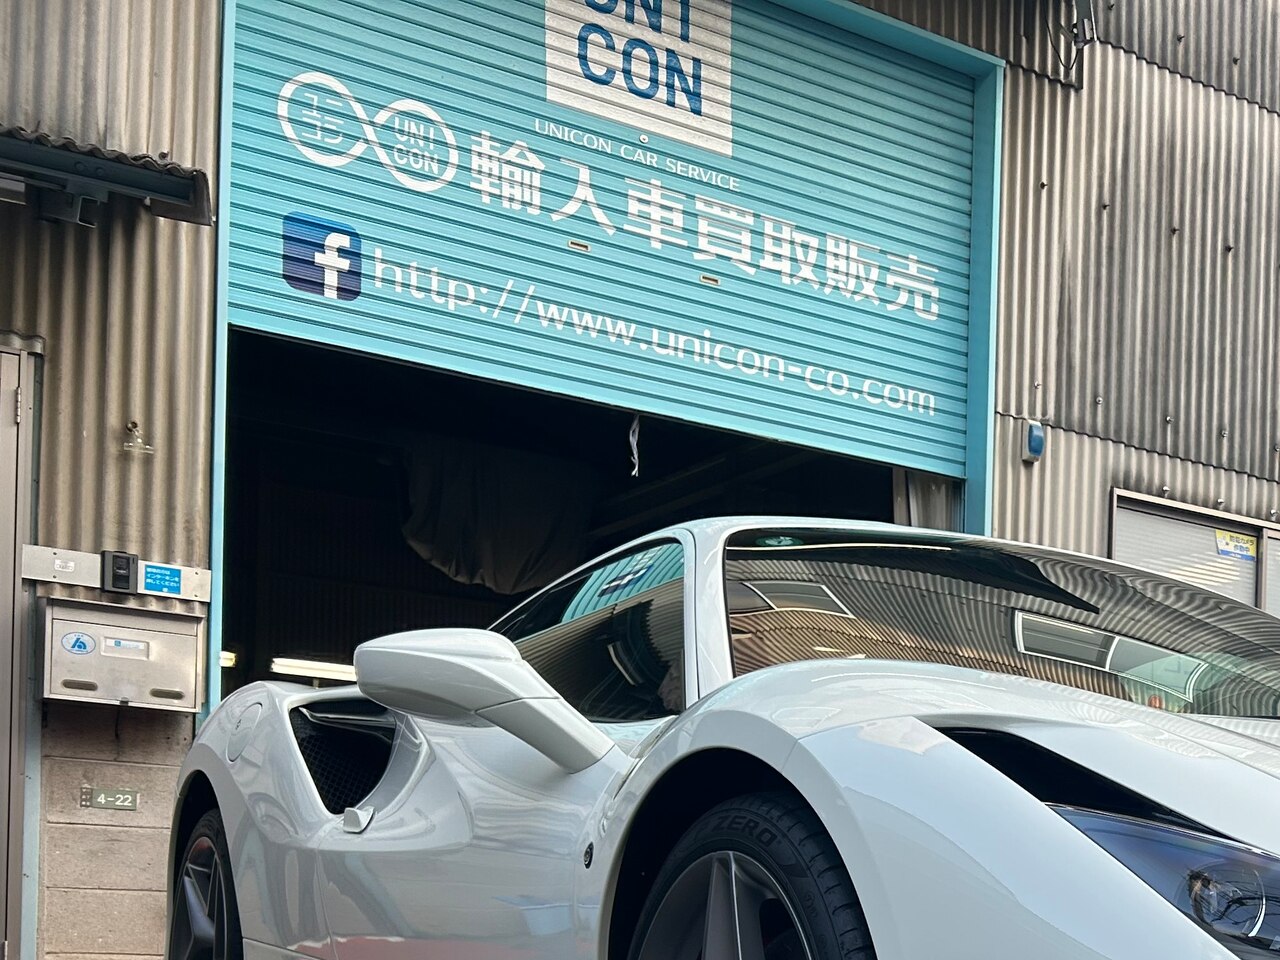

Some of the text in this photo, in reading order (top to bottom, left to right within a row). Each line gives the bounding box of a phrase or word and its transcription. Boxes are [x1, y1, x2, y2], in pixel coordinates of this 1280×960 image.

[577, 23, 703, 116] CON
[393, 144, 439, 174] CON
[394, 117, 435, 150] UNI
[535, 118, 741, 192] UNICON CAR SERVICE
[470, 131, 940, 321] 輸入車買取販売
[373, 247, 936, 416] http://www.unicon-co.com
[97, 793, 132, 806] 4-22
[711, 814, 778, 848] ZERO
